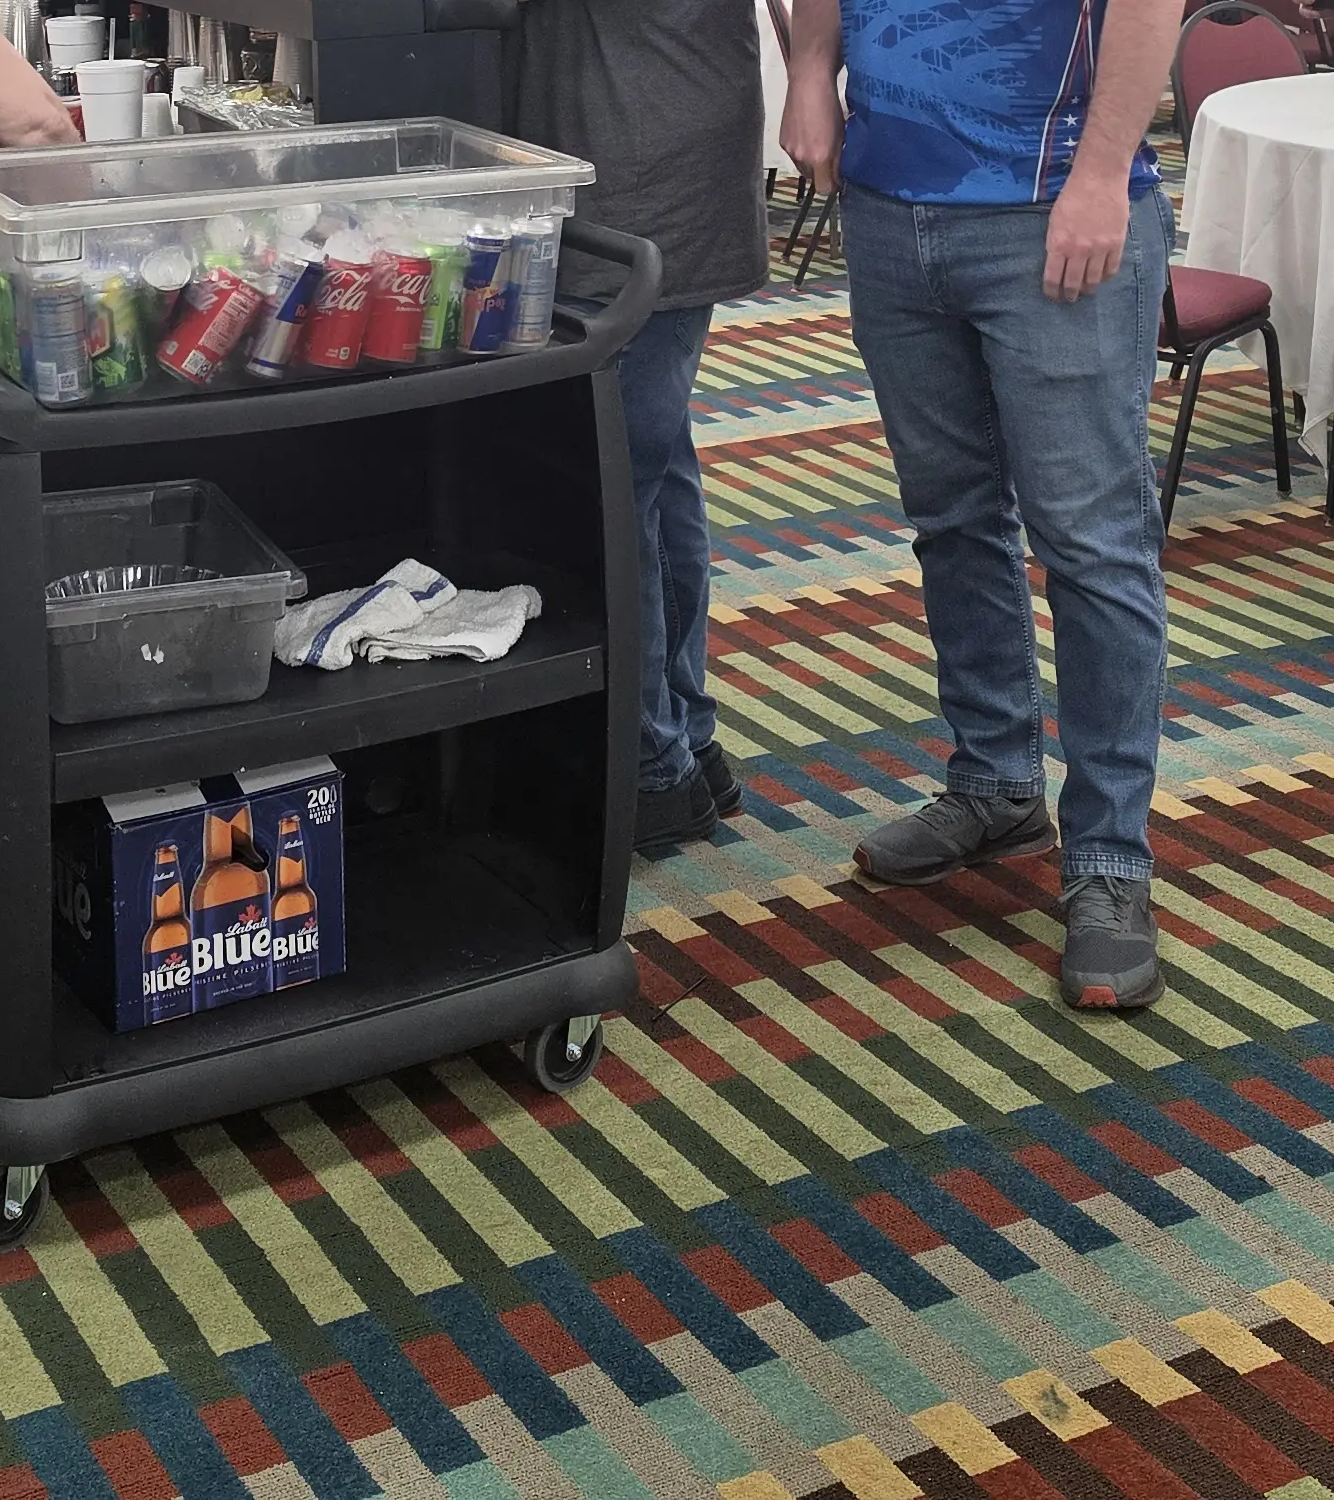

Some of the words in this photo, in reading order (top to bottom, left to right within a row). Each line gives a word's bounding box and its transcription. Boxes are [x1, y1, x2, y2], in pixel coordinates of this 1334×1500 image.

[307, 786, 330, 808] 20
[225, 916, 268, 937] Labatt
[192, 928, 272, 976] Blue
[272, 931, 319, 962] Blue
[143, 966, 191, 996] Blue
